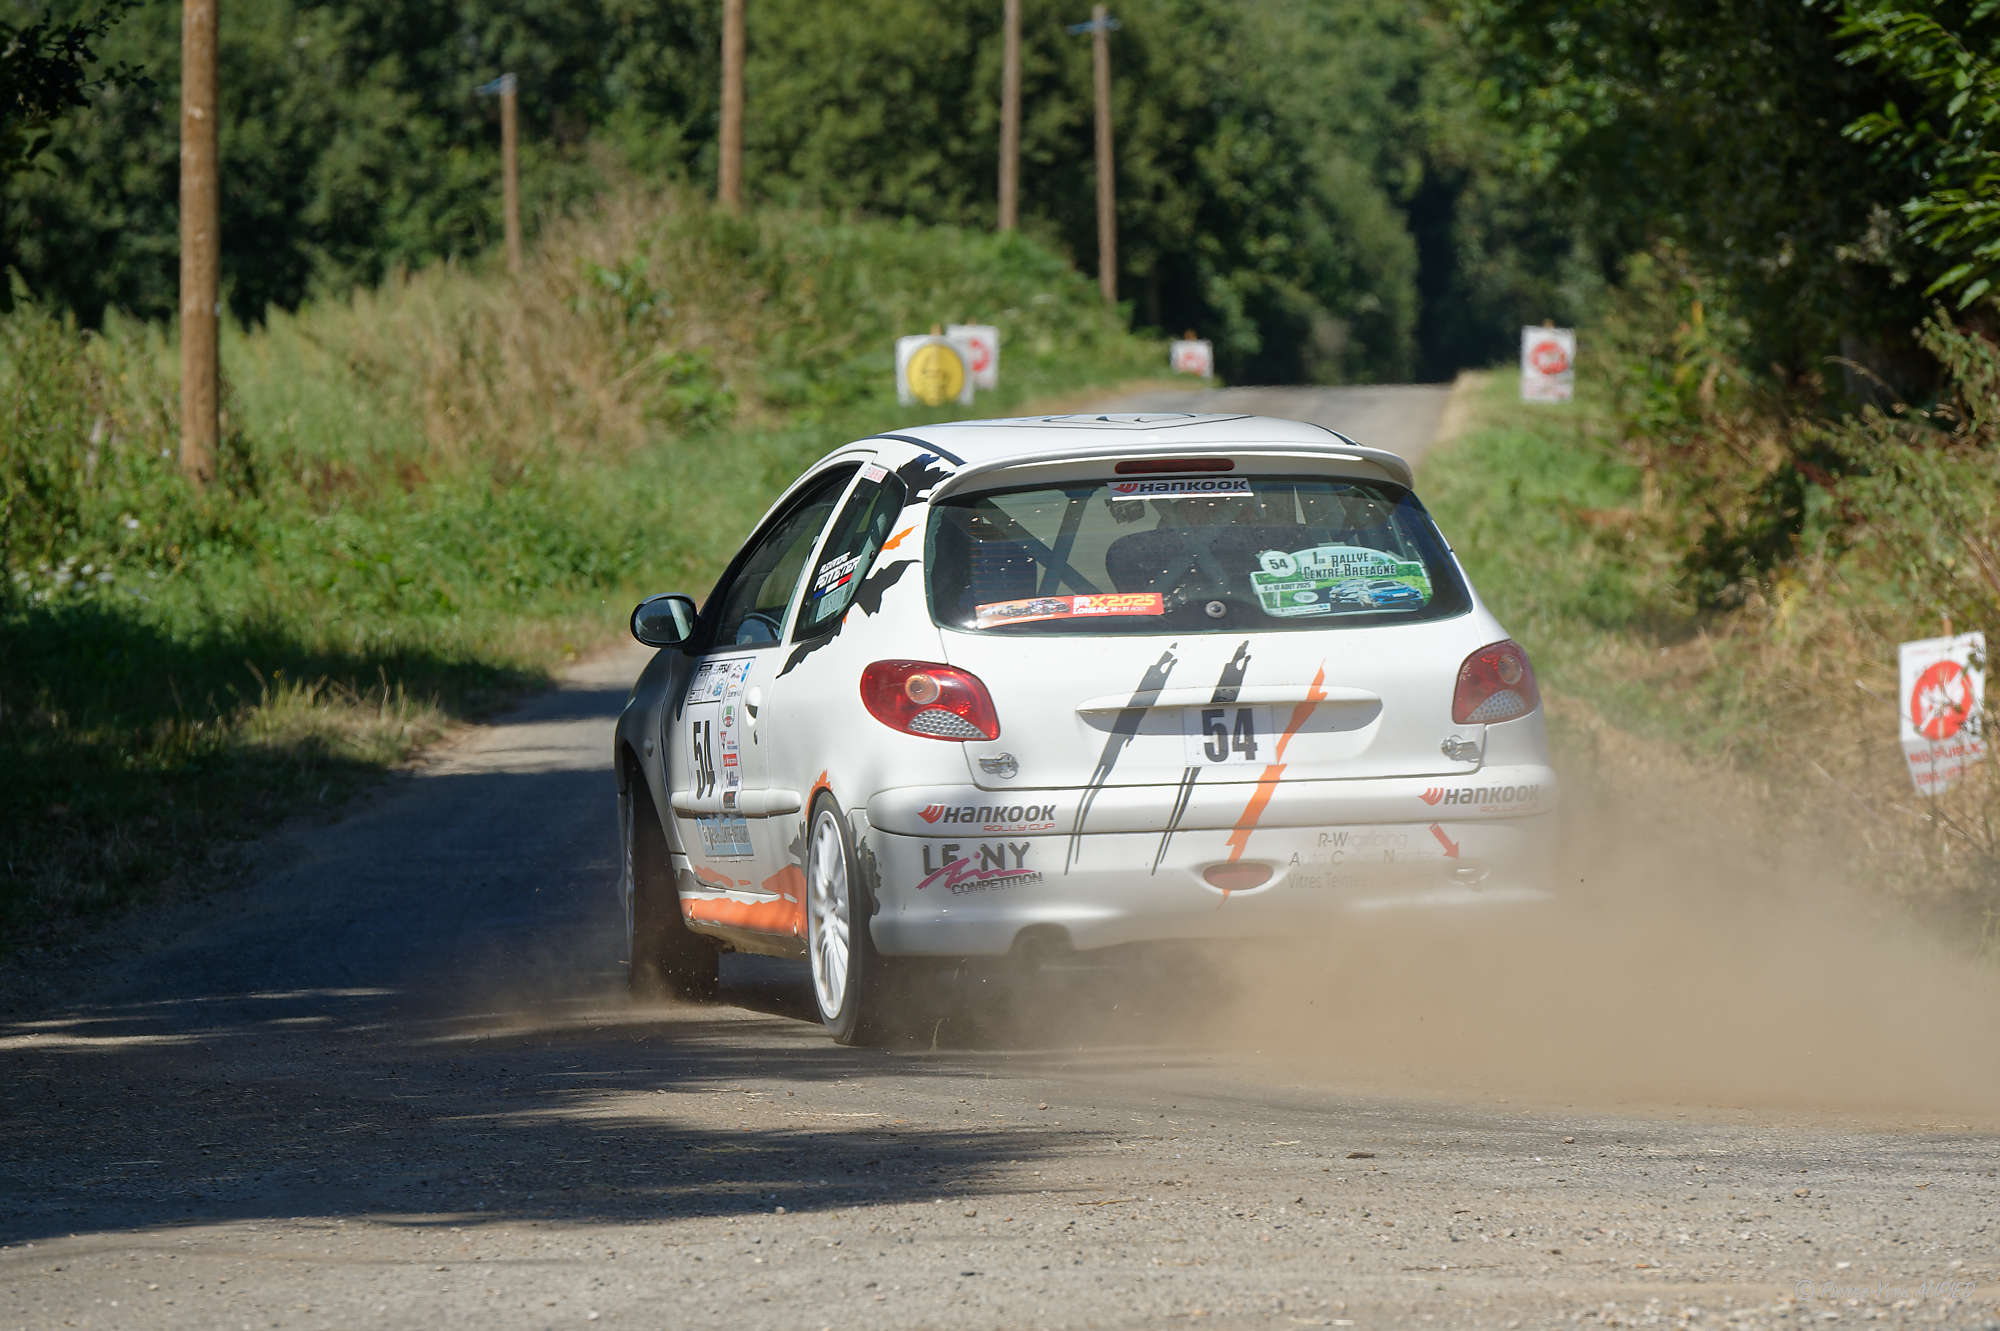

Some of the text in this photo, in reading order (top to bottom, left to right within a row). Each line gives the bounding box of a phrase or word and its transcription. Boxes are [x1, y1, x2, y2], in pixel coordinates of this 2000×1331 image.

[1268, 559, 1289, 570] 54
[1331, 553, 1369, 567] RALLYE
[1201, 707, 1258, 763] 54
[693, 719, 715, 801] 54
[951, 871, 1044, 895] COMPETITION
